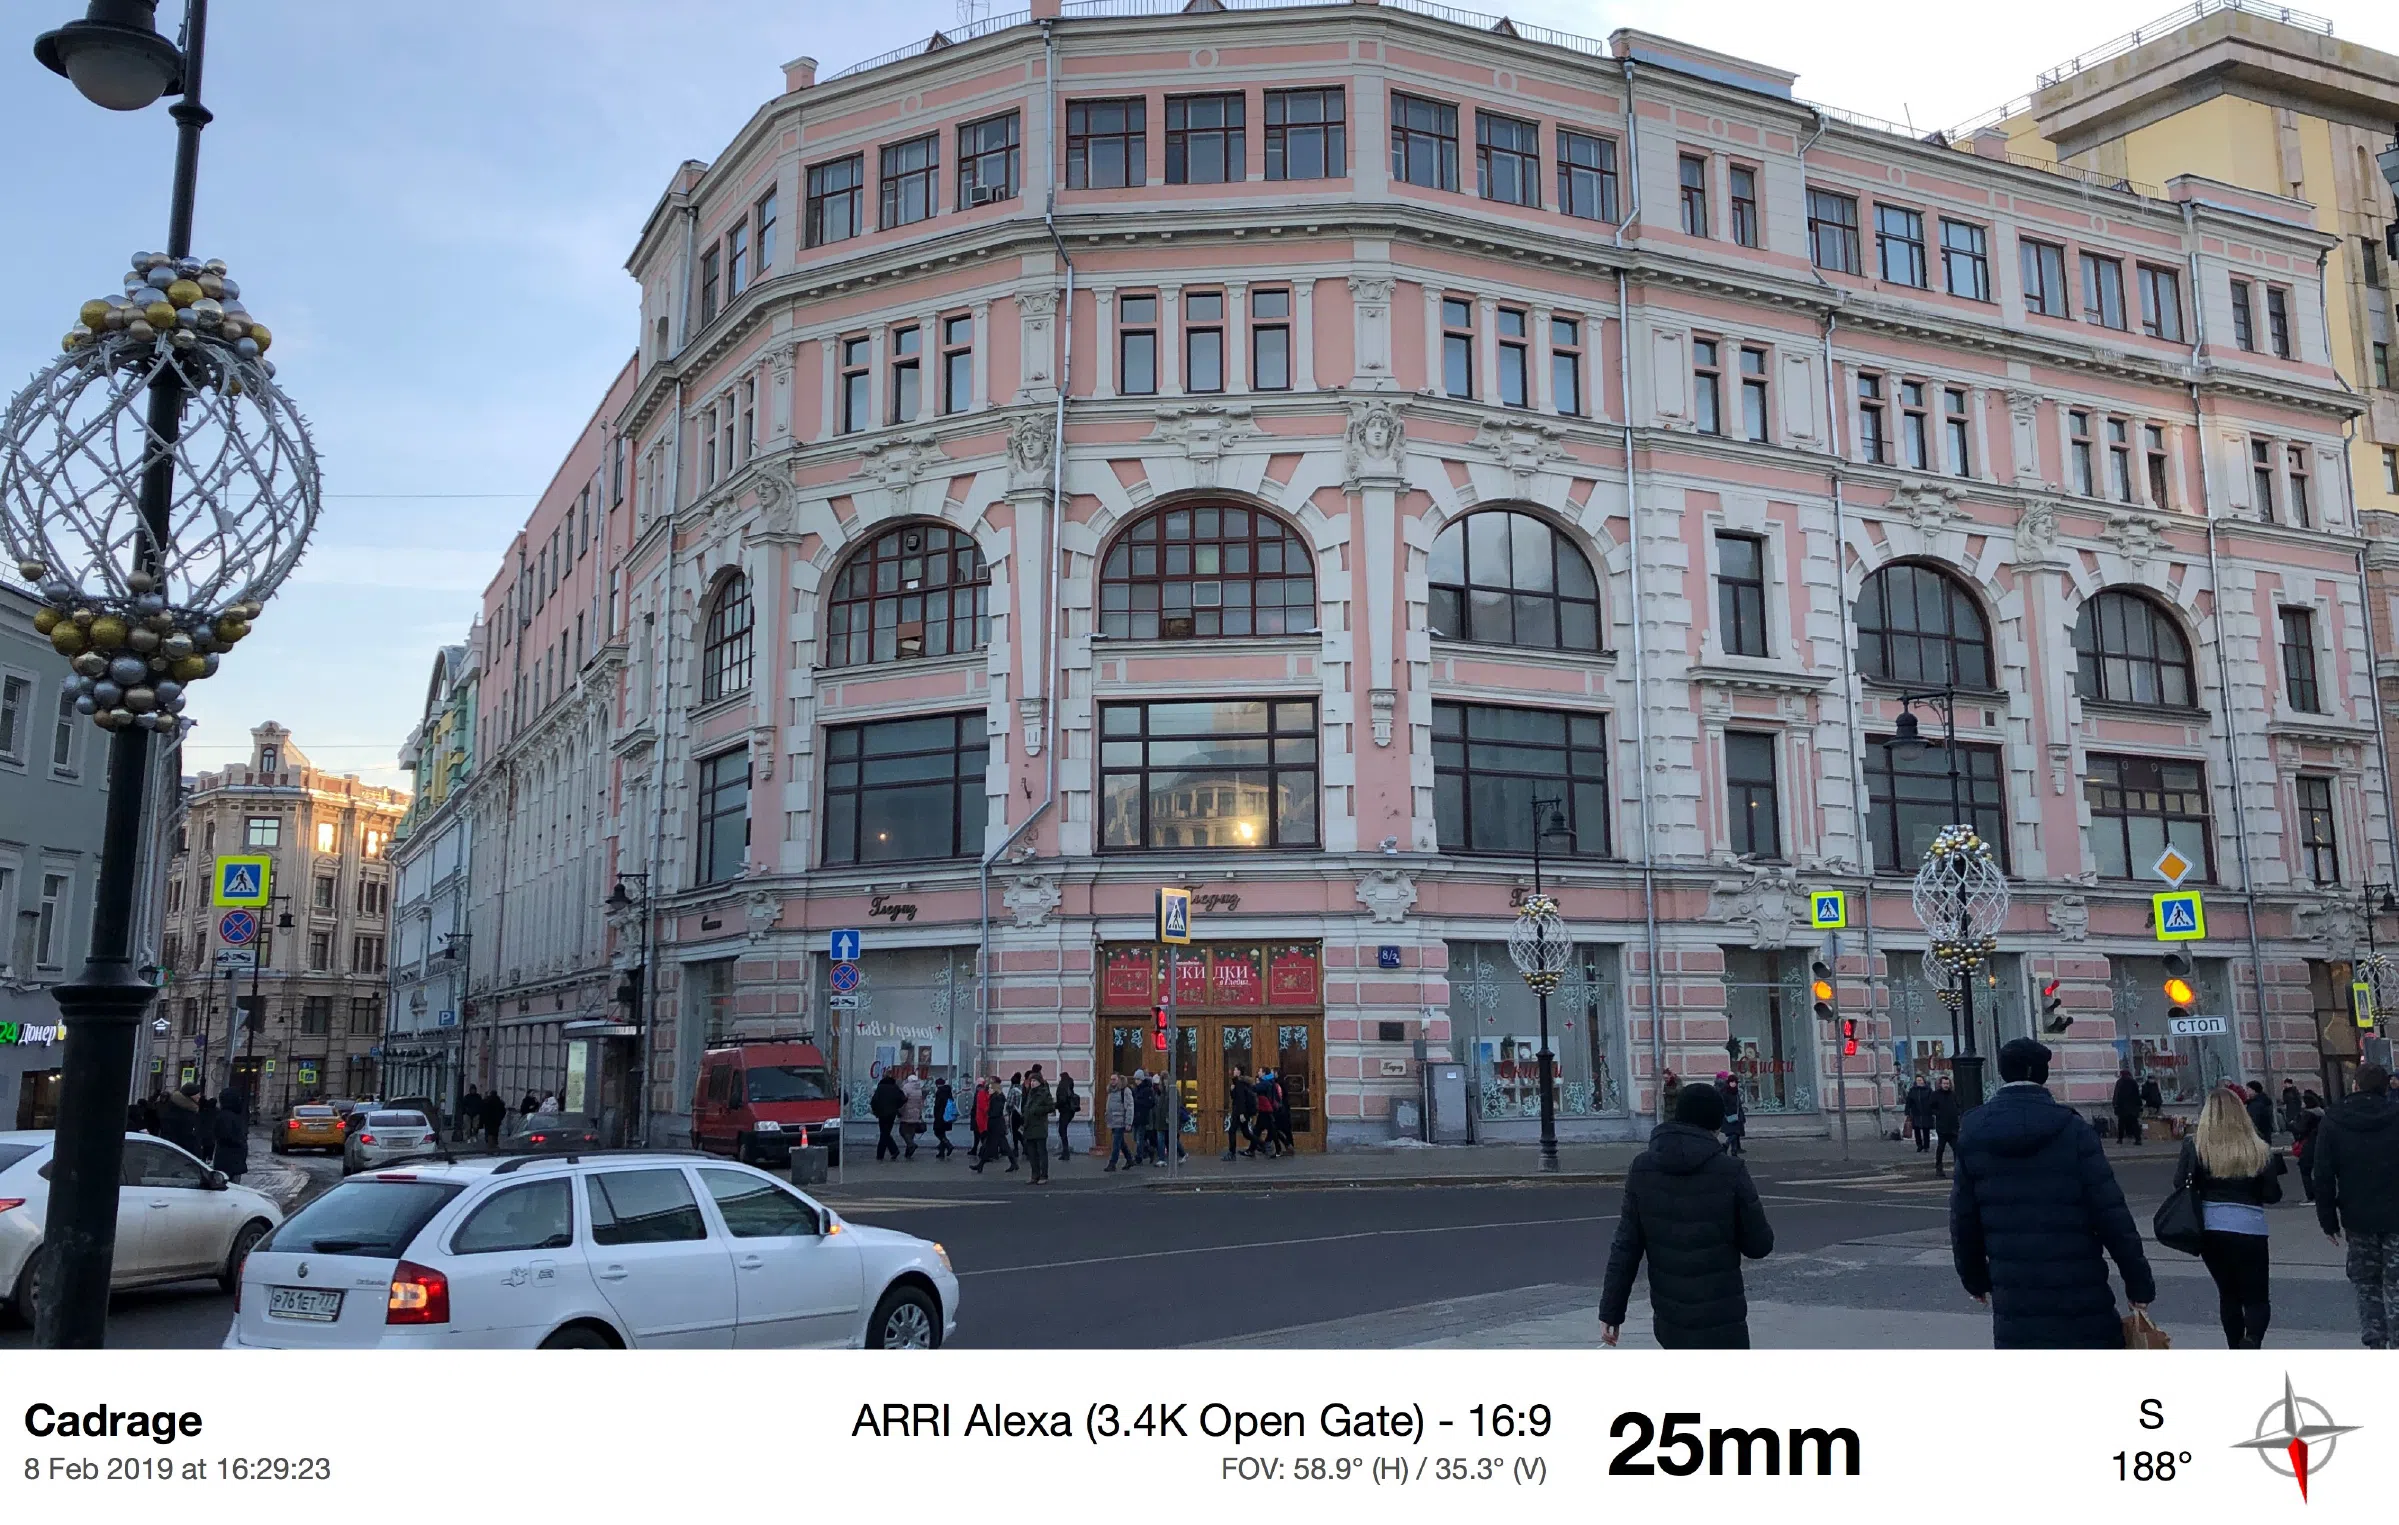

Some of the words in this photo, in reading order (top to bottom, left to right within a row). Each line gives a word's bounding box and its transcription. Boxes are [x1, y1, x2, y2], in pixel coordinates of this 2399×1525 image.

[0, 1021, 17, 1043] 24
[18, 1023, 57, 1047] Донер
[2176, 1019, 2211, 1033] СТОП
